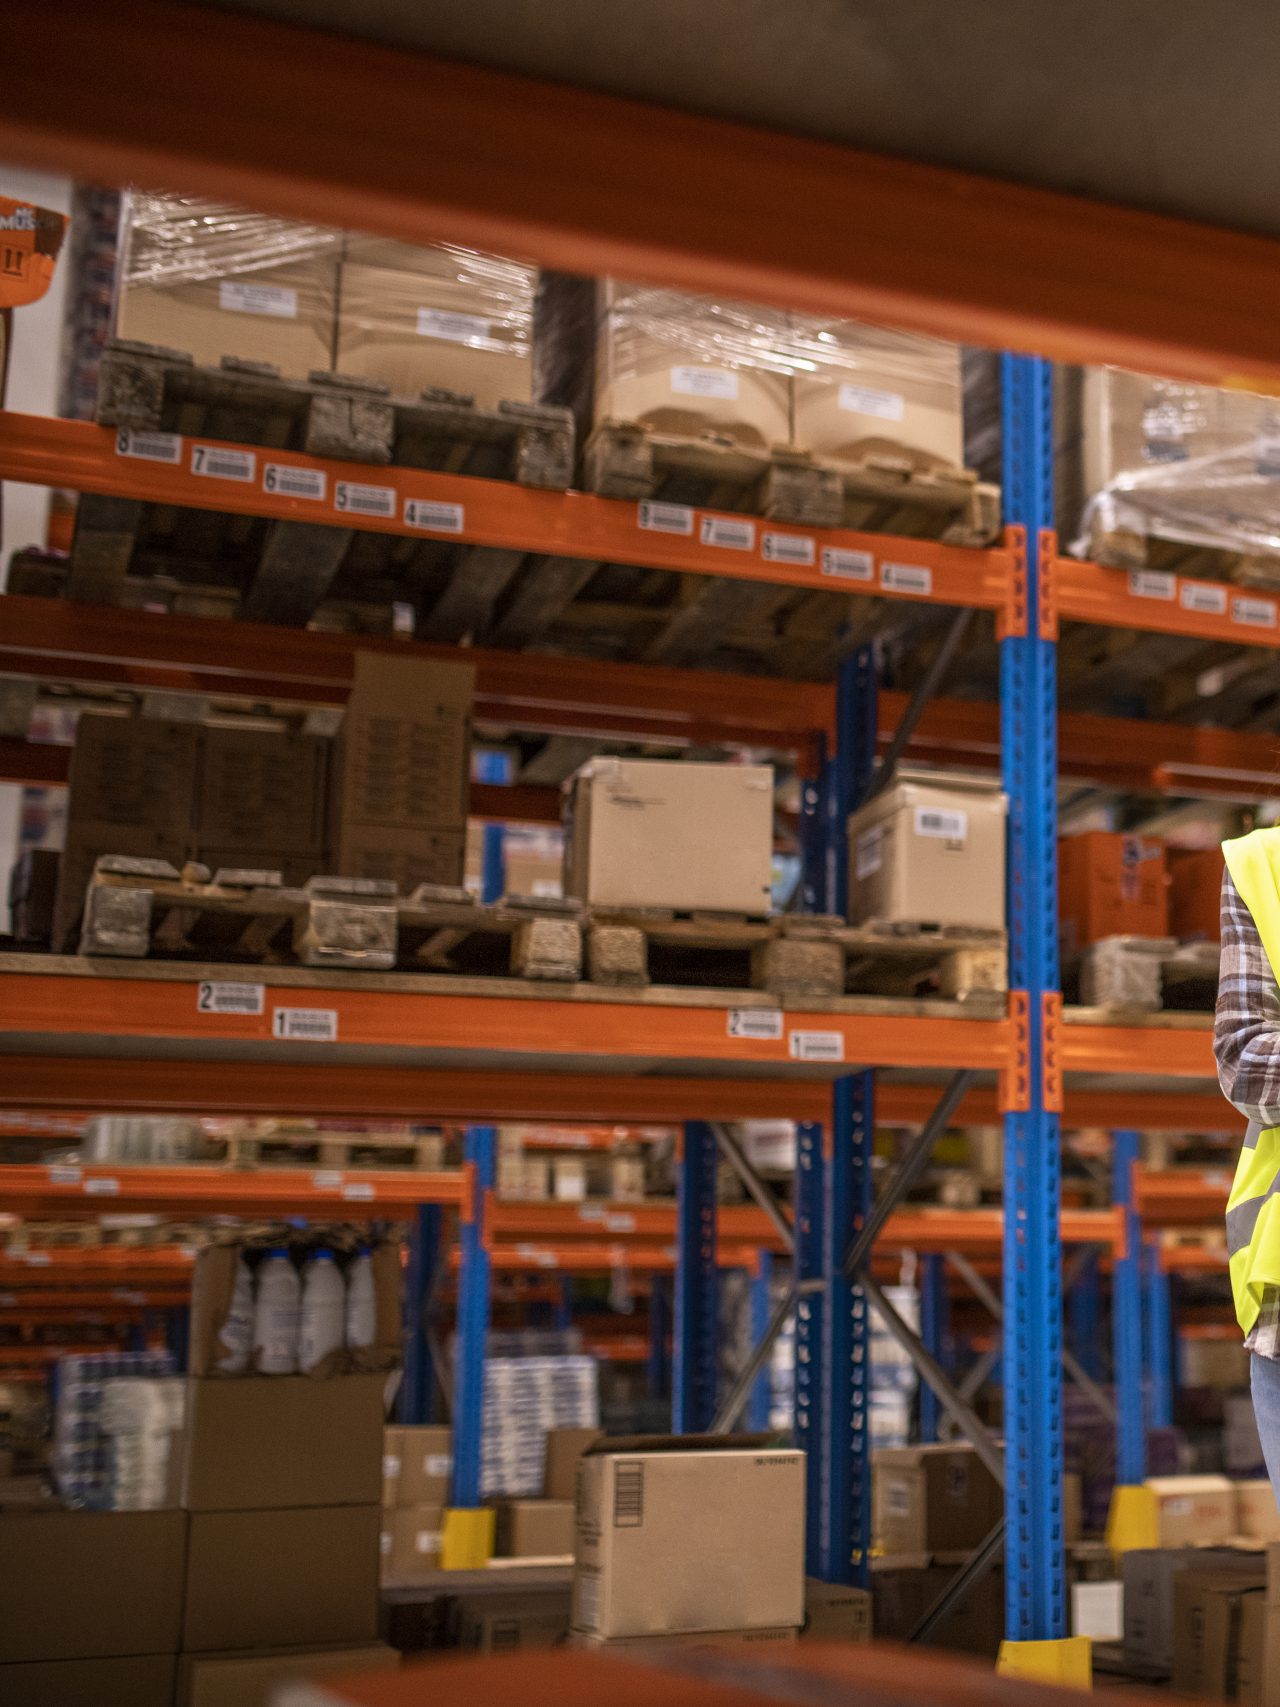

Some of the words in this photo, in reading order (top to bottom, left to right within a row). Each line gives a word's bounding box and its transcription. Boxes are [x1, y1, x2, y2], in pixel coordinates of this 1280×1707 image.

[193, 448, 205, 472] 7
[265, 466, 277, 491] 6
[337, 484, 348, 508] 5
[405, 503, 416, 523] 4
[200, 984, 213, 1009] 2
[277, 1011, 286, 1035] 1
